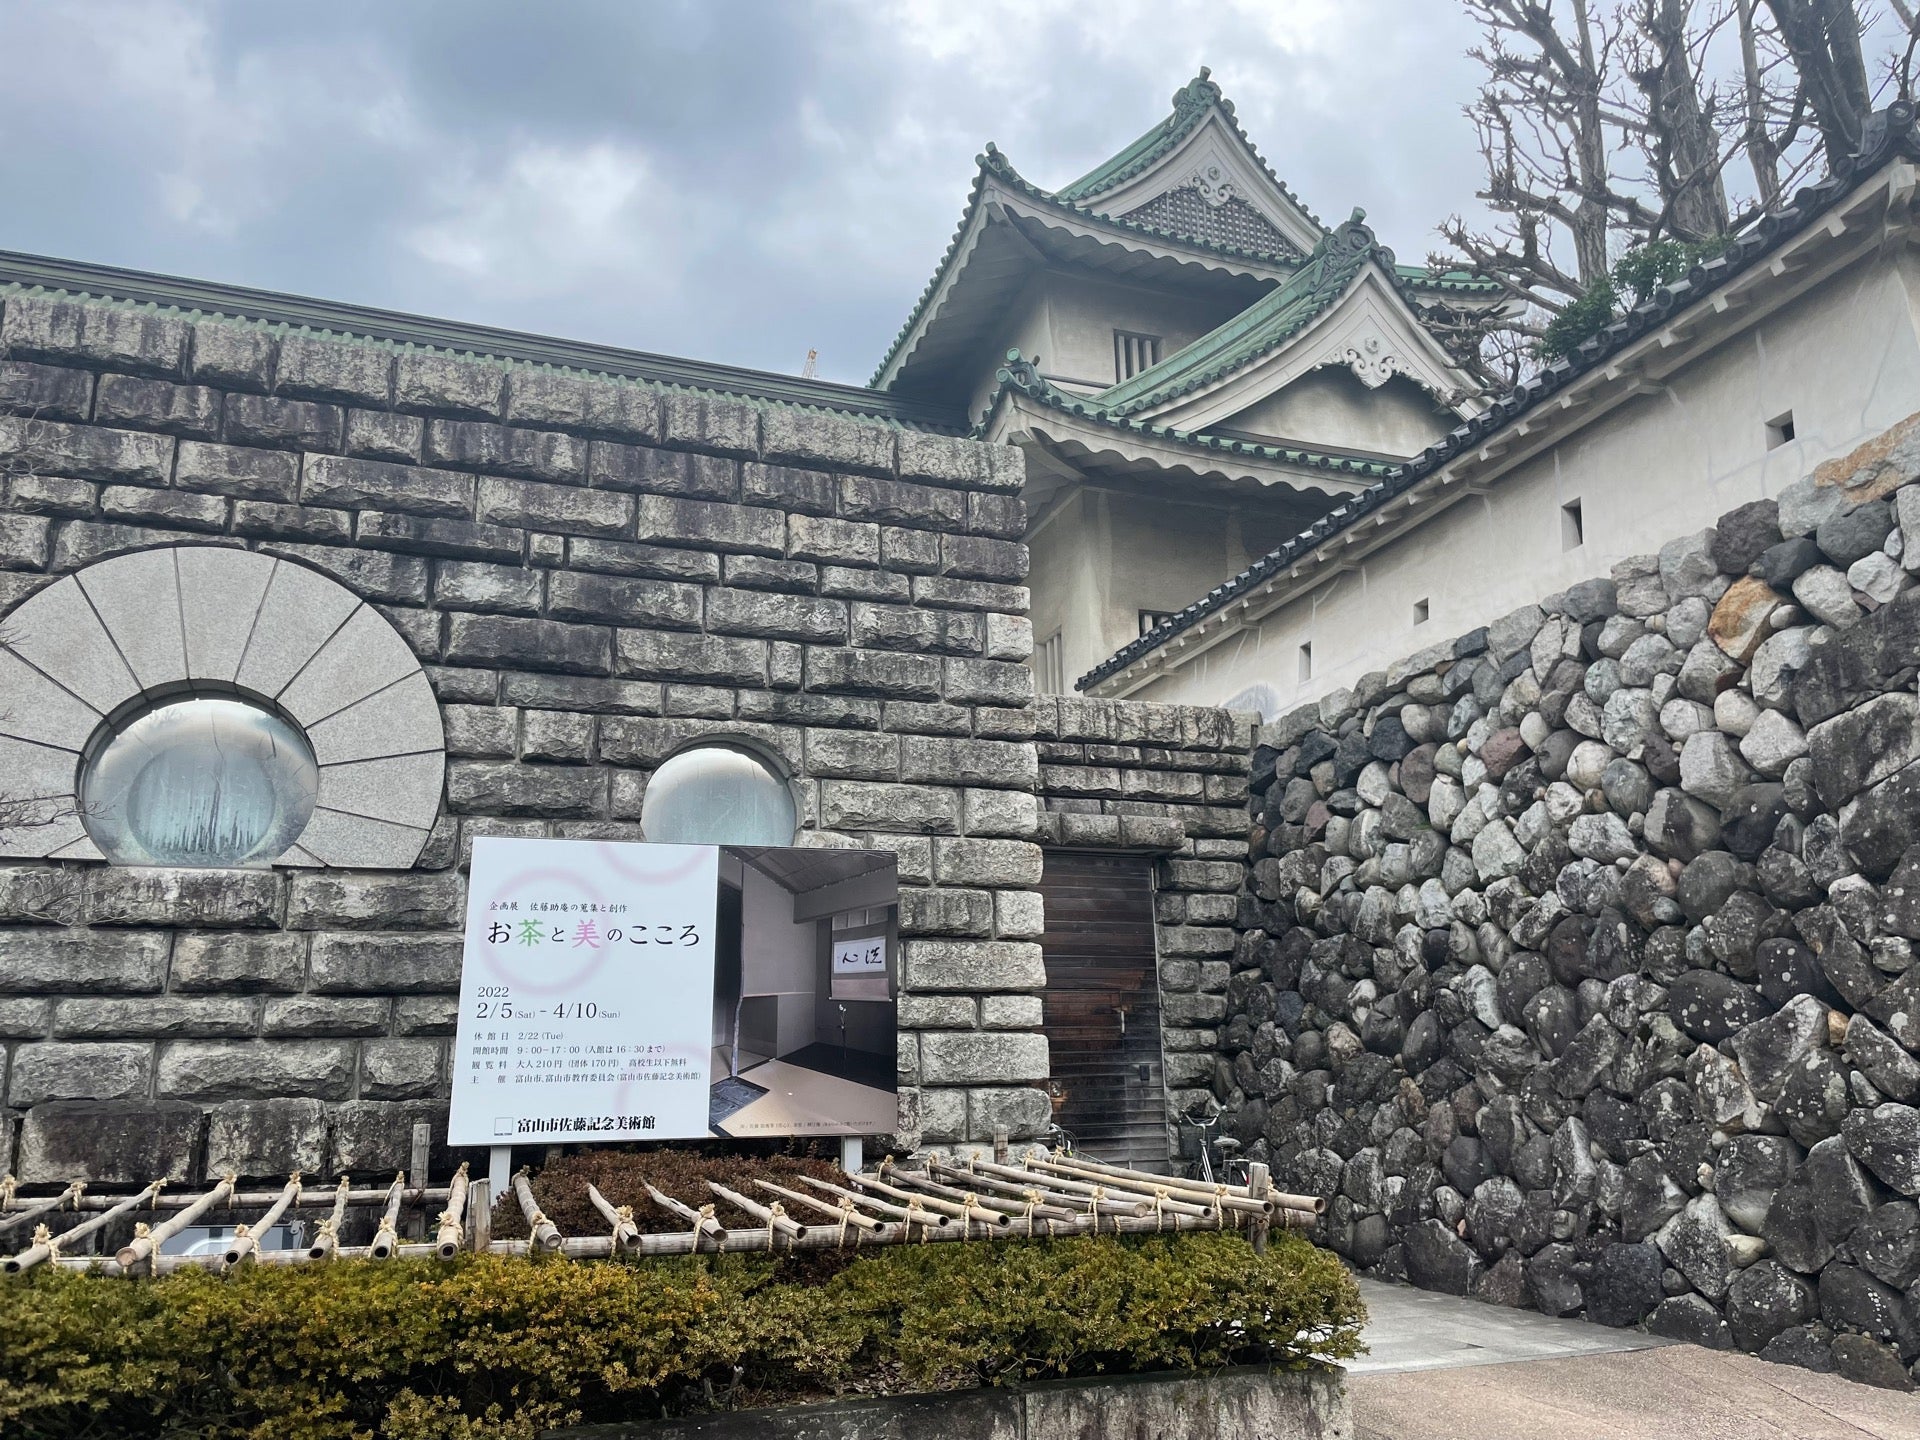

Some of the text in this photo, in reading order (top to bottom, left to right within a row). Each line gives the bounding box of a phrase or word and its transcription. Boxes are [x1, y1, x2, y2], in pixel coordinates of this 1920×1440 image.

[488, 901, 628, 914] 企画展 佐藤助庵の蒐集と創作
[487, 918, 701, 949] お茶と美のこころ
[477, 986, 509, 998] 2022
[517, 1031, 539, 1041] 2/22
[541, 1031, 564, 1041] (Tue)
[472, 1046, 509, 1055] 開館時間
[517, 1115, 656, 1133] 富山市佐藤記念美術館
